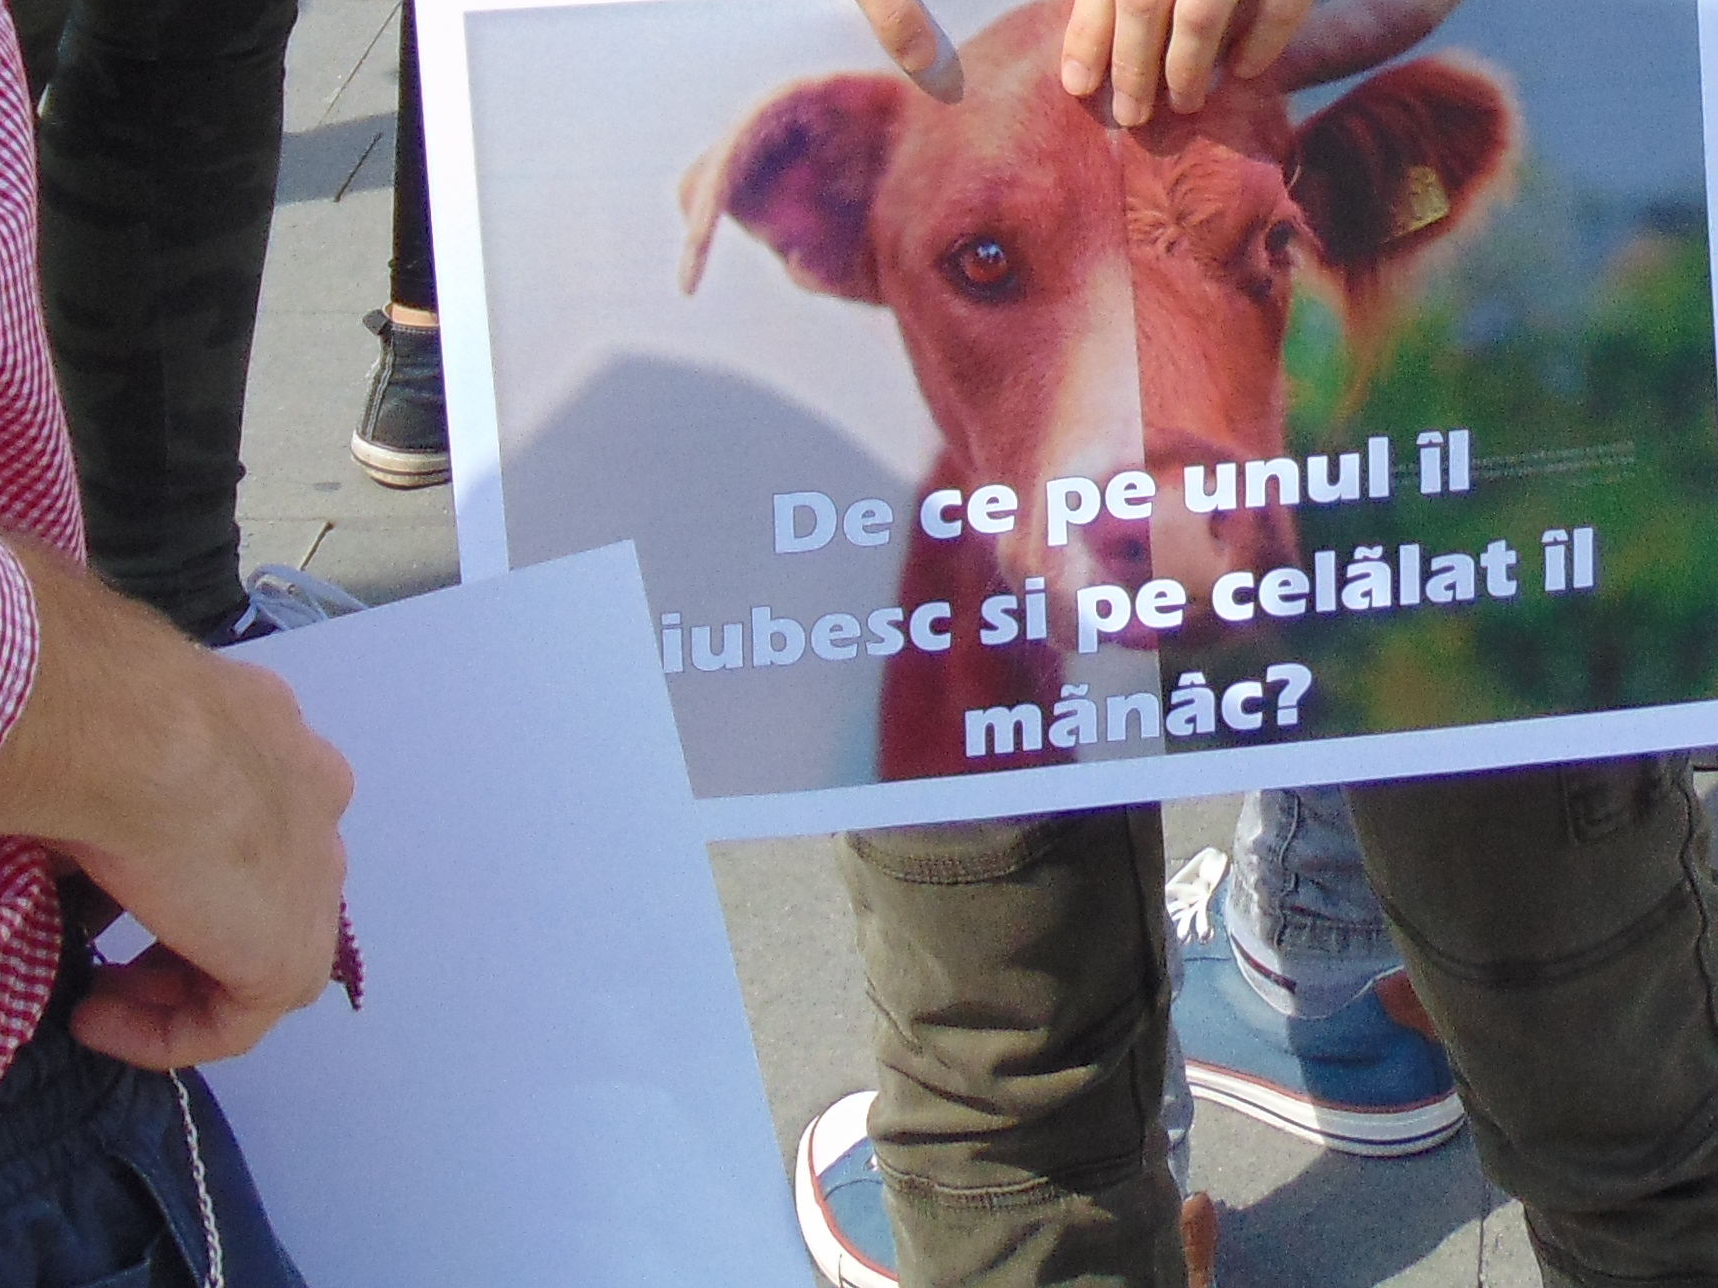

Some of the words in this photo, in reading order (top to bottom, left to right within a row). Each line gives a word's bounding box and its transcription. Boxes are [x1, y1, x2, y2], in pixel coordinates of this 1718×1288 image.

[772, 490, 894, 554] De
[920, 483, 1019, 540] ce
[1045, 470, 1156, 547] pe
[1183, 436, 1390, 513] unul
[1416, 429, 1470, 495] îl
[661, 601, 951, 674] iubesc
[980, 576, 1048, 646] si
[1077, 578, 1187, 654] pe
[1541, 526, 1594, 592] îl
